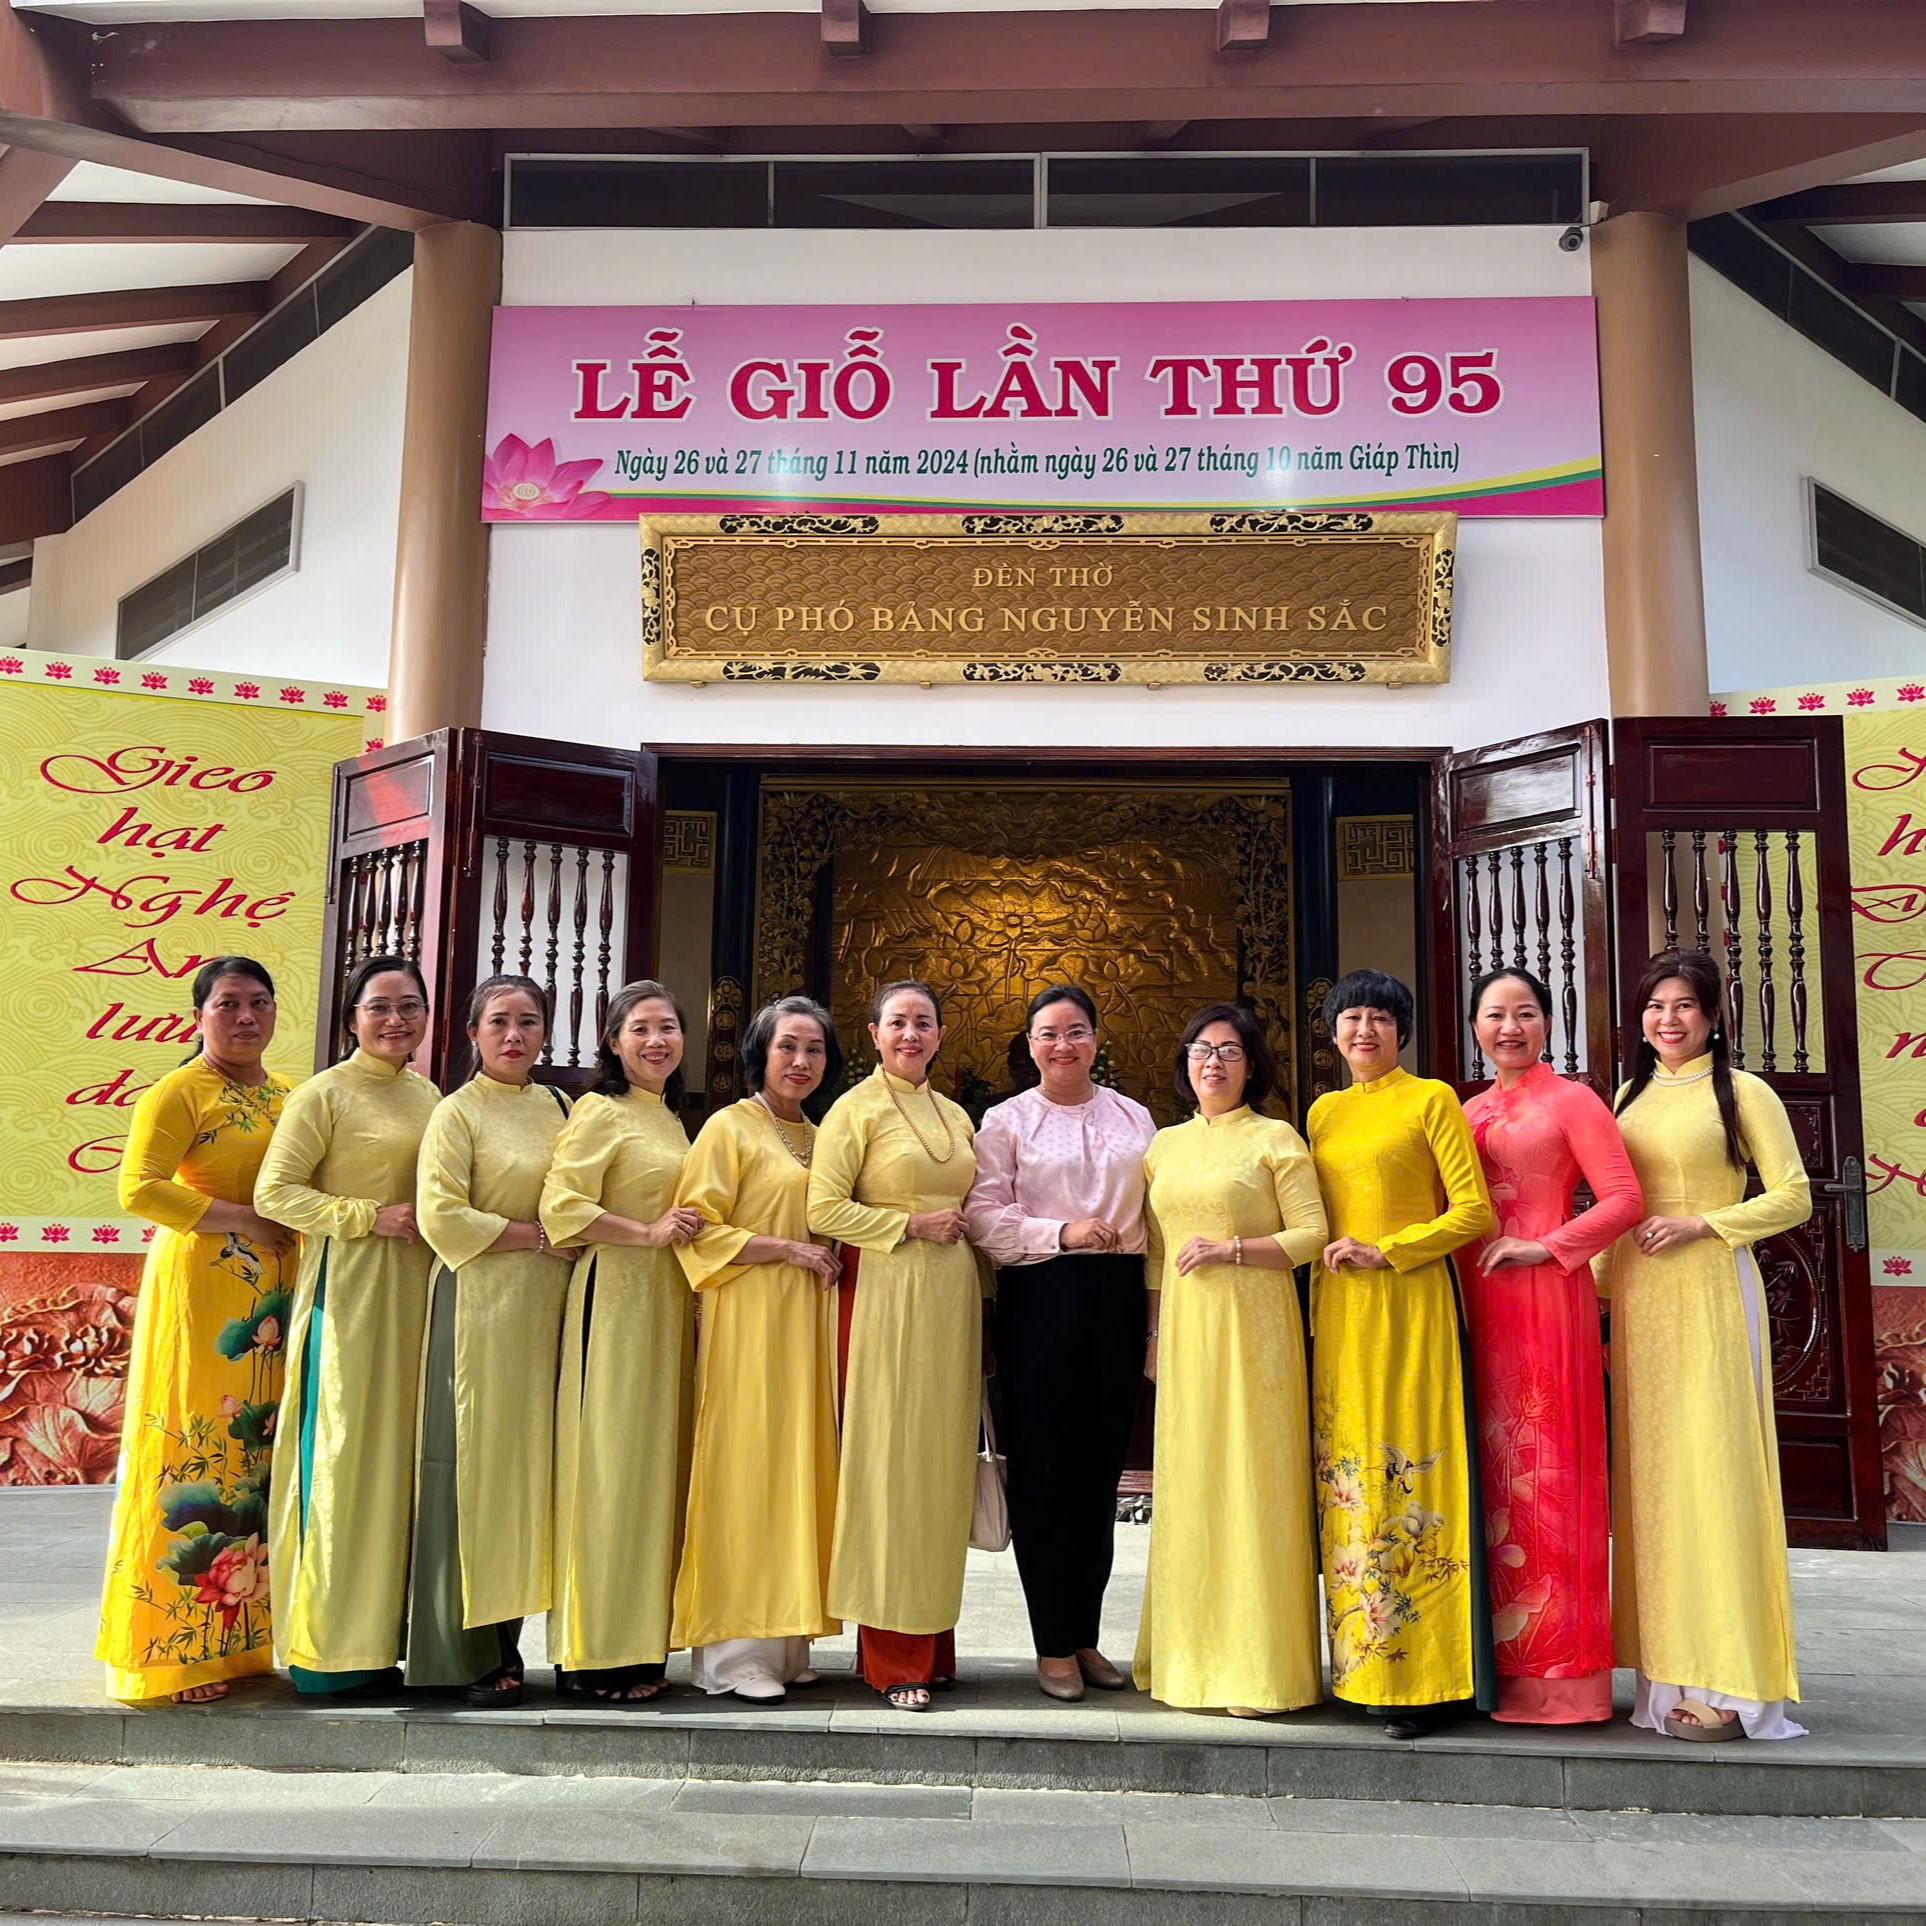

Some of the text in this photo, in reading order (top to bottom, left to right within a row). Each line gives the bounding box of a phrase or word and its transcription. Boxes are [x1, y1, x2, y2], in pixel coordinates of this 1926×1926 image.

[572, 324, 1502, 421] LỄ GIỖ LẦN THỨ 95
[614, 441, 1460, 481] Ngày 26 và 27 tháng 11 năm 2024 (nhằm ngày 26 và 27 tháng 10 năm Giáp Thìn)
[972, 561, 1113, 587] ĐỀN THỜ
[705, 598, 1387, 636] CỤ PHÓ BẢNG NGUYỄN SINH SẮC
[40, 746, 277, 794] Gieo
[96, 807, 228, 858] hạt
[10, 865, 296, 928] Nghệ
[86, 1002, 199, 1043] lưu
